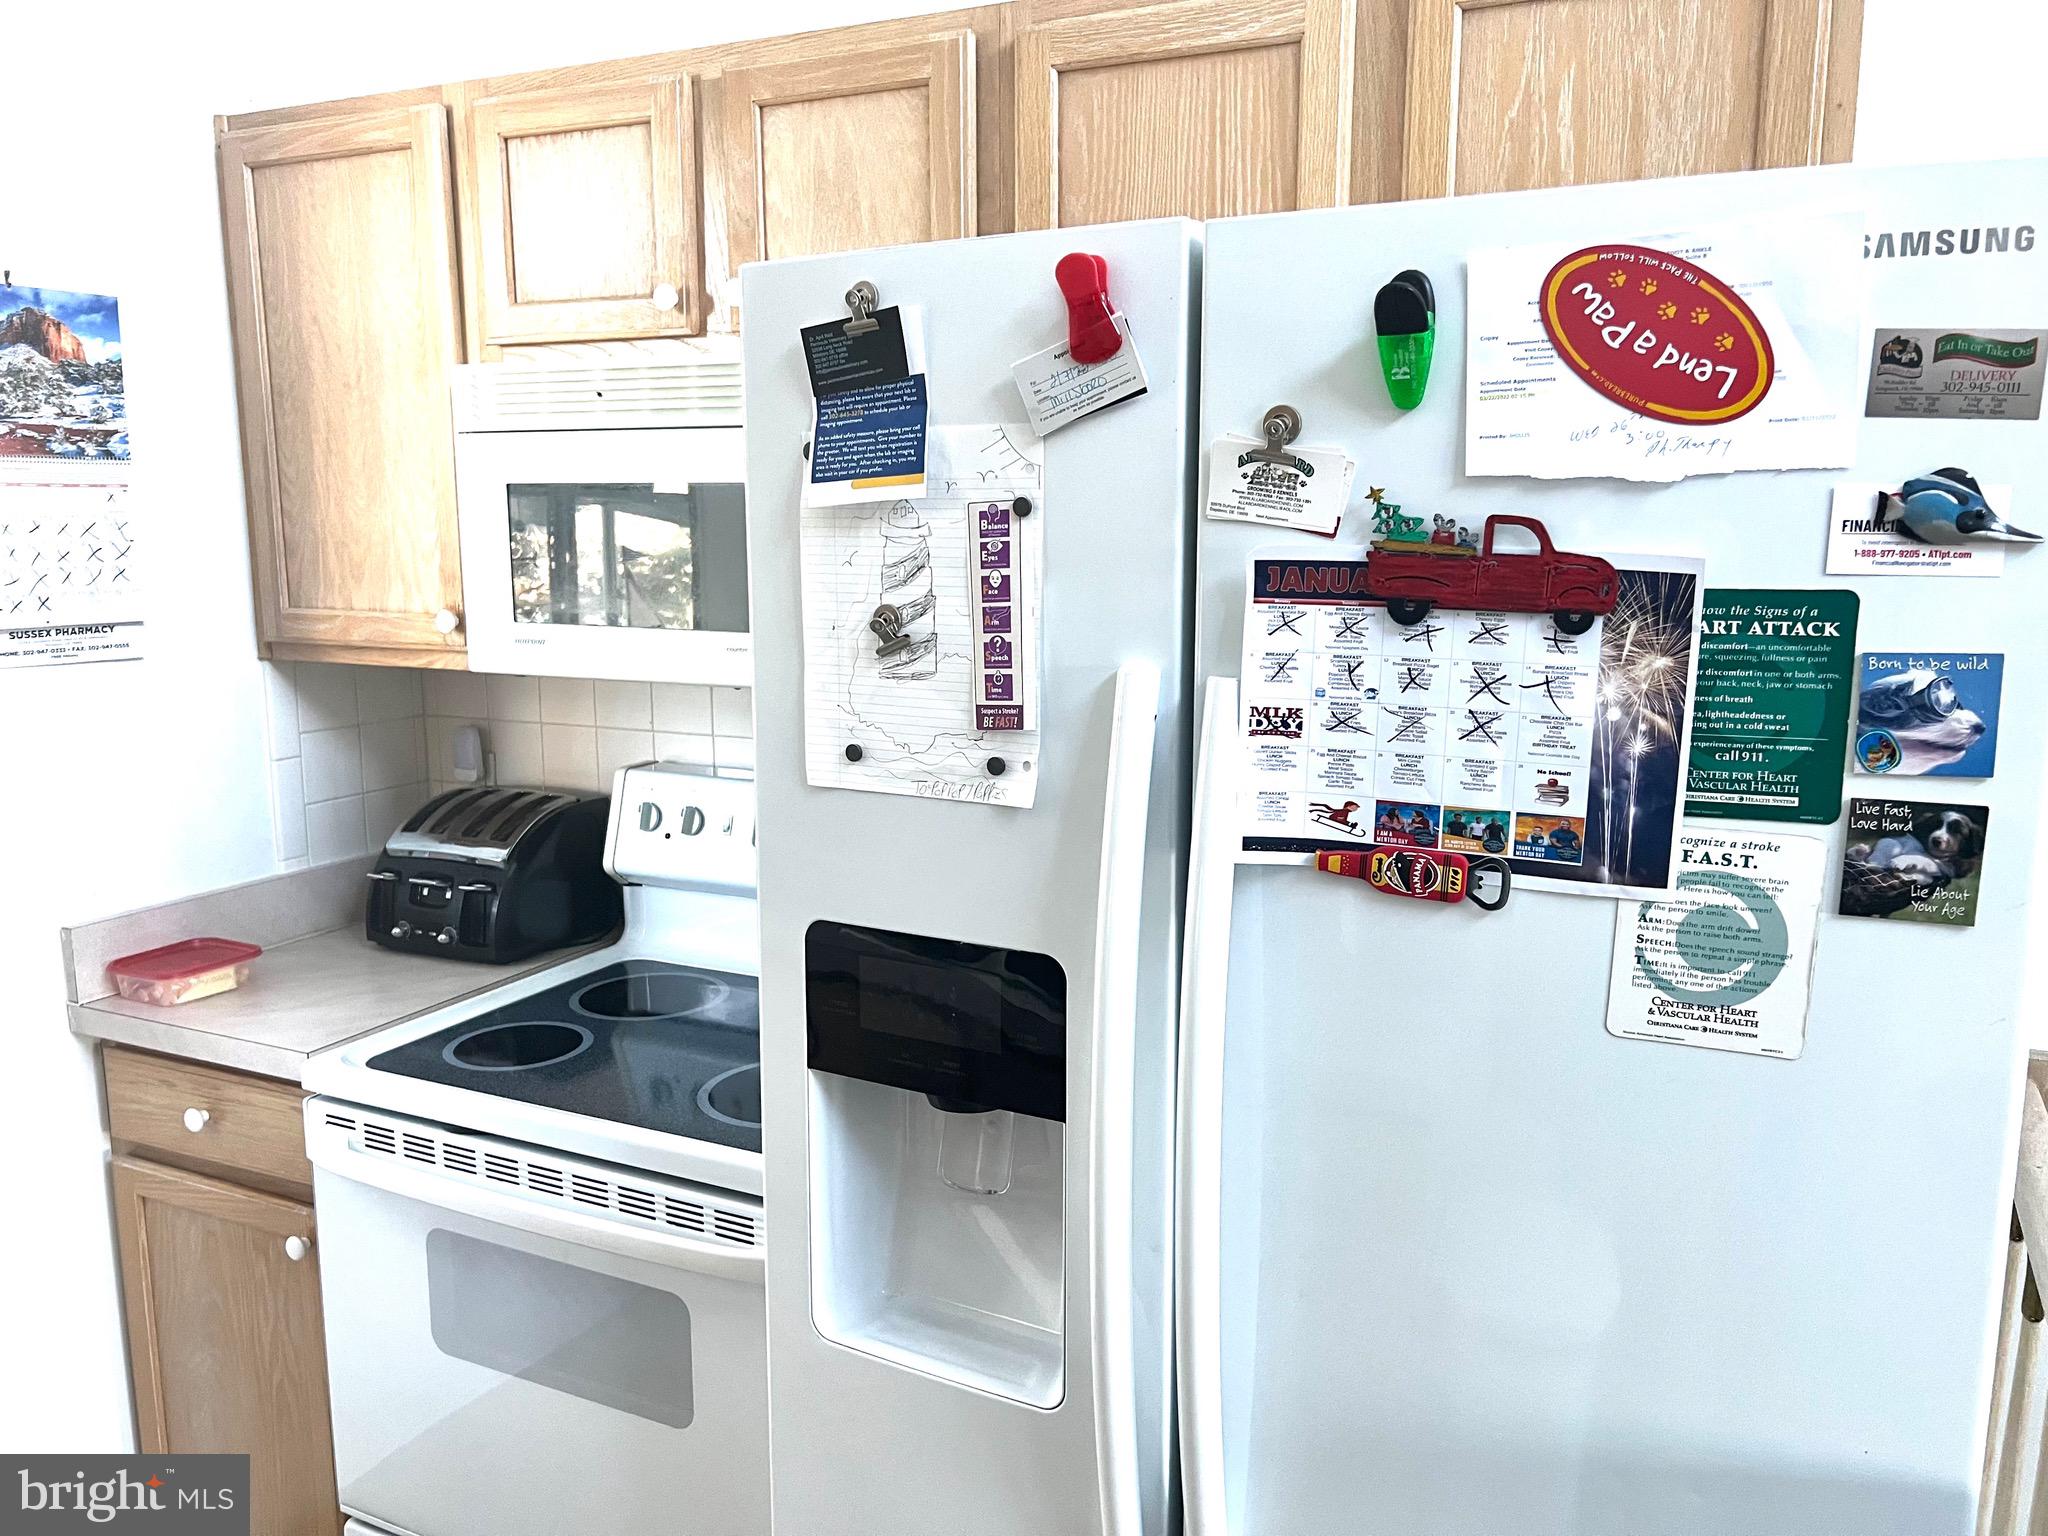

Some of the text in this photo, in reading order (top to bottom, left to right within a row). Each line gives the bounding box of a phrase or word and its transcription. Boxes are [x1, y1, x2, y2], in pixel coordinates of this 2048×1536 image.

[1600, 252, 1699, 285] THE PACK WILL FOLLOW
[1572, 282, 1738, 399] Lend a Paw
[1938, 340, 1956, 354] Eat
[1958, 340, 1968, 350] In
[1985, 344, 2010, 358] Take
[2012, 346, 2035, 358] Out
[1951, 370, 2017, 382] DELIVERY
[1940, 382, 2022, 394] 302-945-0111
[981, 520, 1008, 530] Balance
[982, 550, 998, 562] Eyes
[1854, 549, 1920, 558] 1-888-977-9205
[1267, 566, 1369, 594] JANUA
[983, 584, 998, 595] Face
[1730, 604, 1750, 616] the
[1754, 606, 1788, 619] Signs
[1793, 606, 1808, 620] of
[1810, 608, 1818, 616] a
[984, 616, 1000, 626] Arm
[9, 625, 116, 640] SUSSEX PHARMACY
[1747, 620, 1840, 637] ATTACK
[986, 650, 1008, 662] Speech
[1868, 656, 1990, 670] Born to be wild
[1706, 668, 1752, 677] discomfort
[1794, 670, 1815, 678] both
[986, 682, 1002, 694] Time
[1714, 694, 1724, 702] of
[1726, 695, 1753, 703] breath
[1249, 706, 1304, 719] MLK
[1705, 709, 1774, 720] lightheadedness
[984, 716, 1018, 728] BE FAST!
[1726, 721, 1734, 729] in
[1744, 722, 1762, 730] cold
[1764, 723, 1790, 731] sweat
[1715, 750, 1739, 761] call
[1732, 772, 1754, 780] FOR
[1757, 770, 1798, 783] HEART
[1690, 778, 1799, 794] VASCULAR HEALTH
[1856, 802, 1912, 819] Live Fast,
[1851, 816, 1913, 832] Love Hard
[1730, 840, 1738, 848] a
[1741, 842, 1780, 852] stroke
[1681, 849, 1758, 870] F.A.S.T.
[1413, 858, 1426, 893] PANAMA
[1910, 884, 1970, 900] Lie About
[1911, 901, 1966, 918] Your Age
[1638, 913, 1666, 925] ARM:
[1666, 918, 1684, 927] Does
[1636, 934, 1674, 947] SPEECH:
[1634, 954, 1662, 968] TIME:
[1652, 996, 1758, 1018] CENTER FOR HEART
[1656, 1006, 1710, 1022] VASCULAR
[1714, 1014, 1759, 1028] HEALTH
[1646, 1020, 1683, 1030] CHRISTIANA
[1708, 1027, 1734, 1036] HEALTH
[1734, 1030, 1758, 1039] SYSTEM
